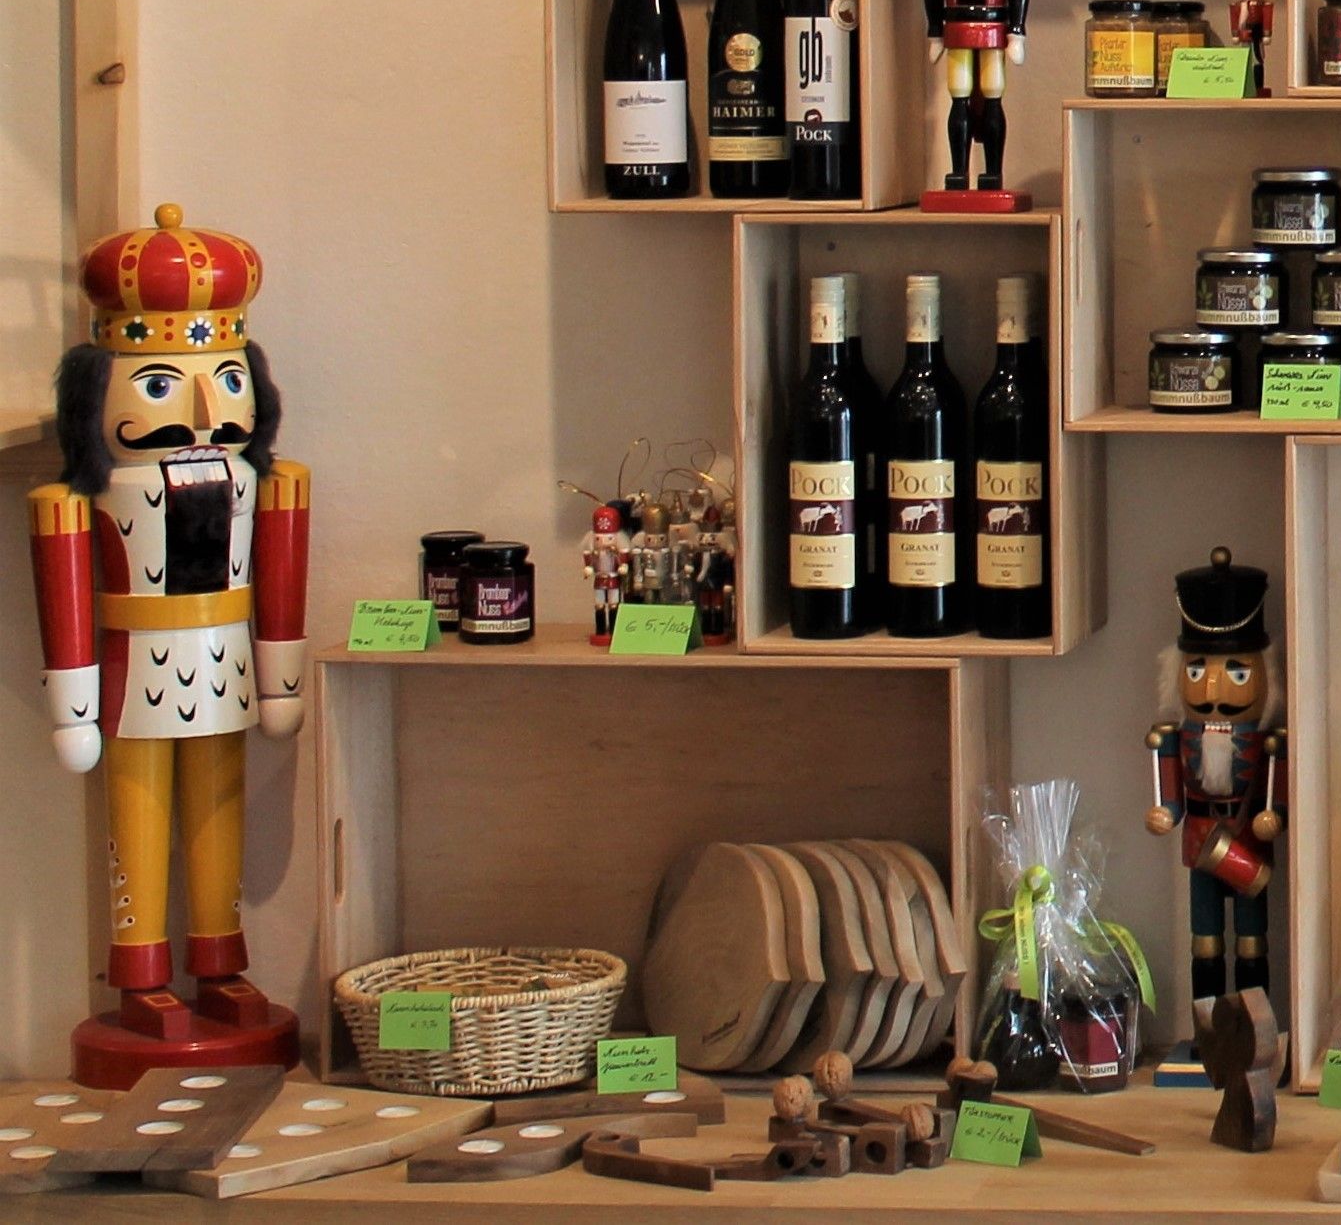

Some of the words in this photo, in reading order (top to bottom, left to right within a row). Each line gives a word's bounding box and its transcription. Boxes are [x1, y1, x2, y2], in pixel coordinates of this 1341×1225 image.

[713, 106, 776, 118] HAIMER
[623, 165, 661, 176] ZULL
[477, 600, 502, 617] Nuss
